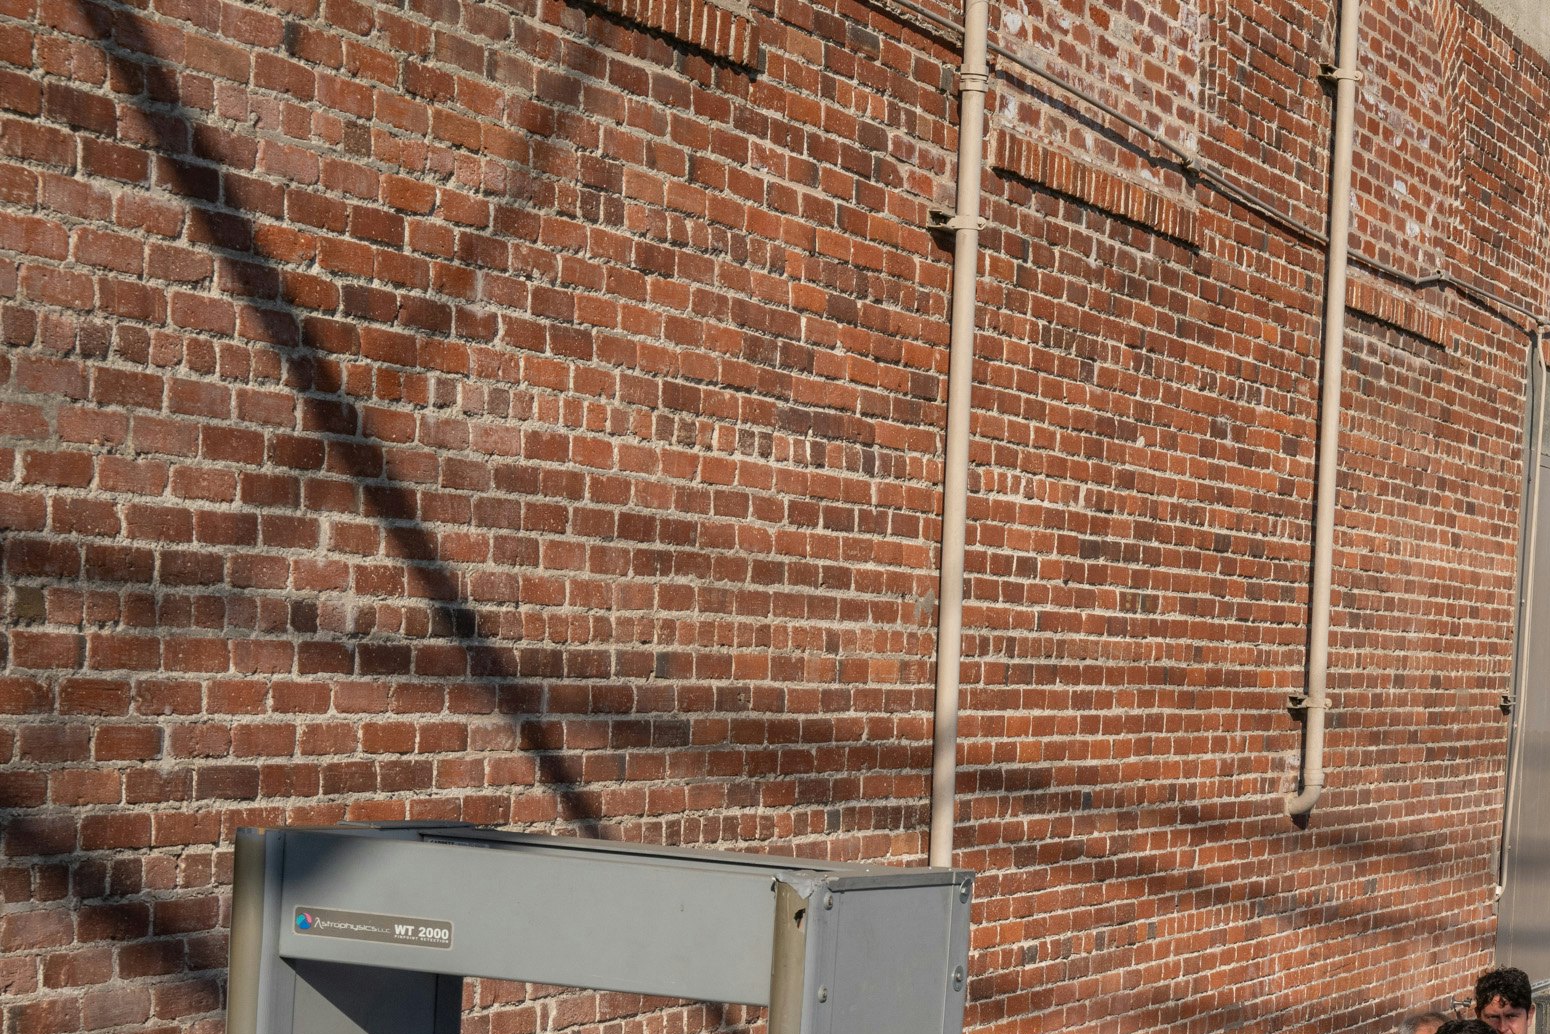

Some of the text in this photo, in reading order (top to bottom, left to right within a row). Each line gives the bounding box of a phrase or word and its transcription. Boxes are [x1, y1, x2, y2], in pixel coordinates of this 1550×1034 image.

[314, 917, 377, 932] Astrophysics
[394, 924, 415, 936] WT
[418, 926, 449, 940] 2000
